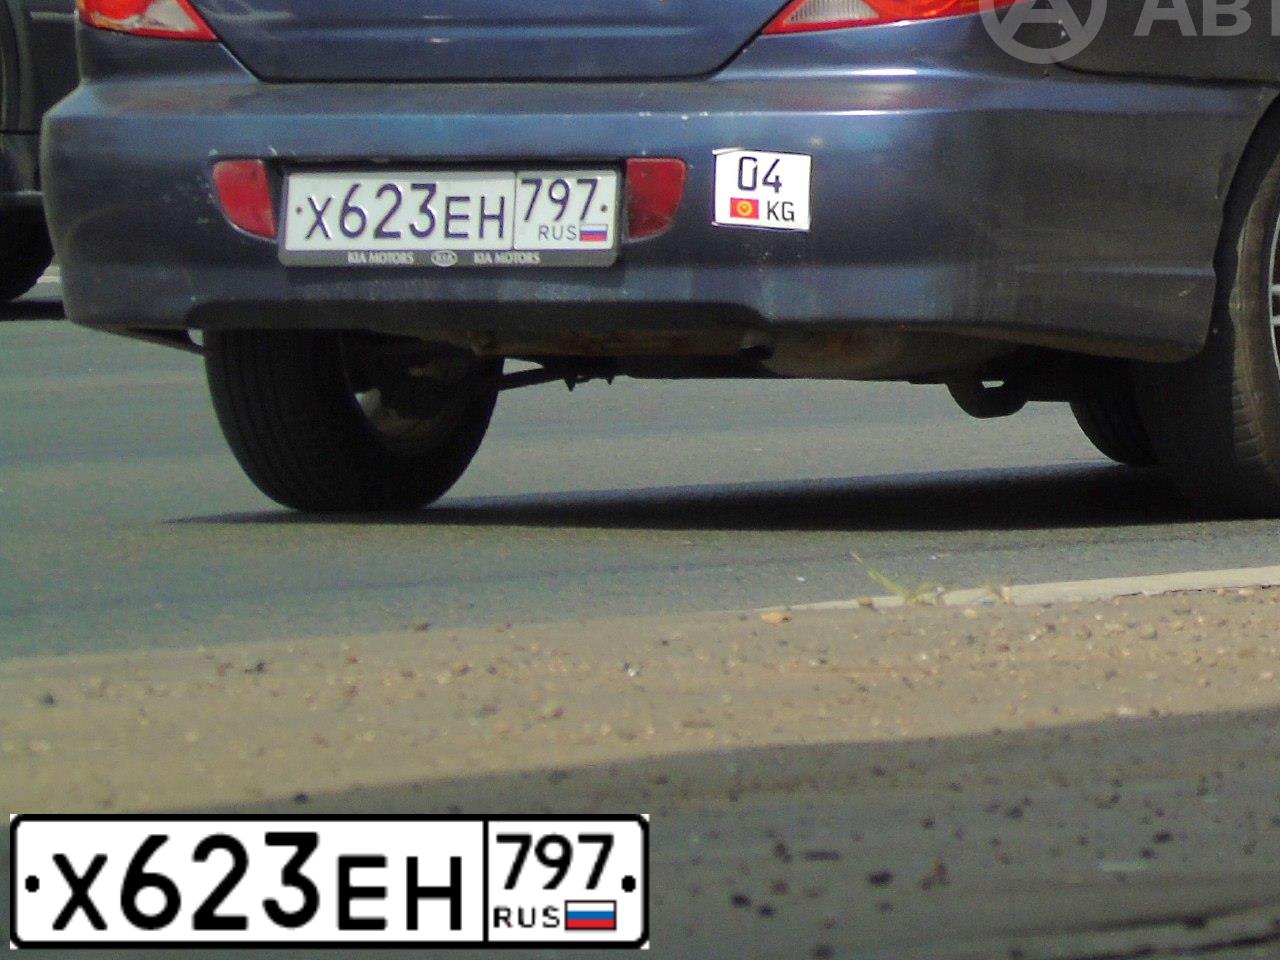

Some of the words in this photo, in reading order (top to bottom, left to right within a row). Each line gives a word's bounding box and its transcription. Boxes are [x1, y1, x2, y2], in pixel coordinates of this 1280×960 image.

[737, 156, 783, 193] 04
[305, 182, 506, 241] Х623ЕН
[521, 177, 600, 223] 797
[767, 201, 795, 222] KG
[538, 225, 577, 240] RUS
[368, 251, 415, 264] MOTORS
[494, 251, 541, 264] MOTORS
